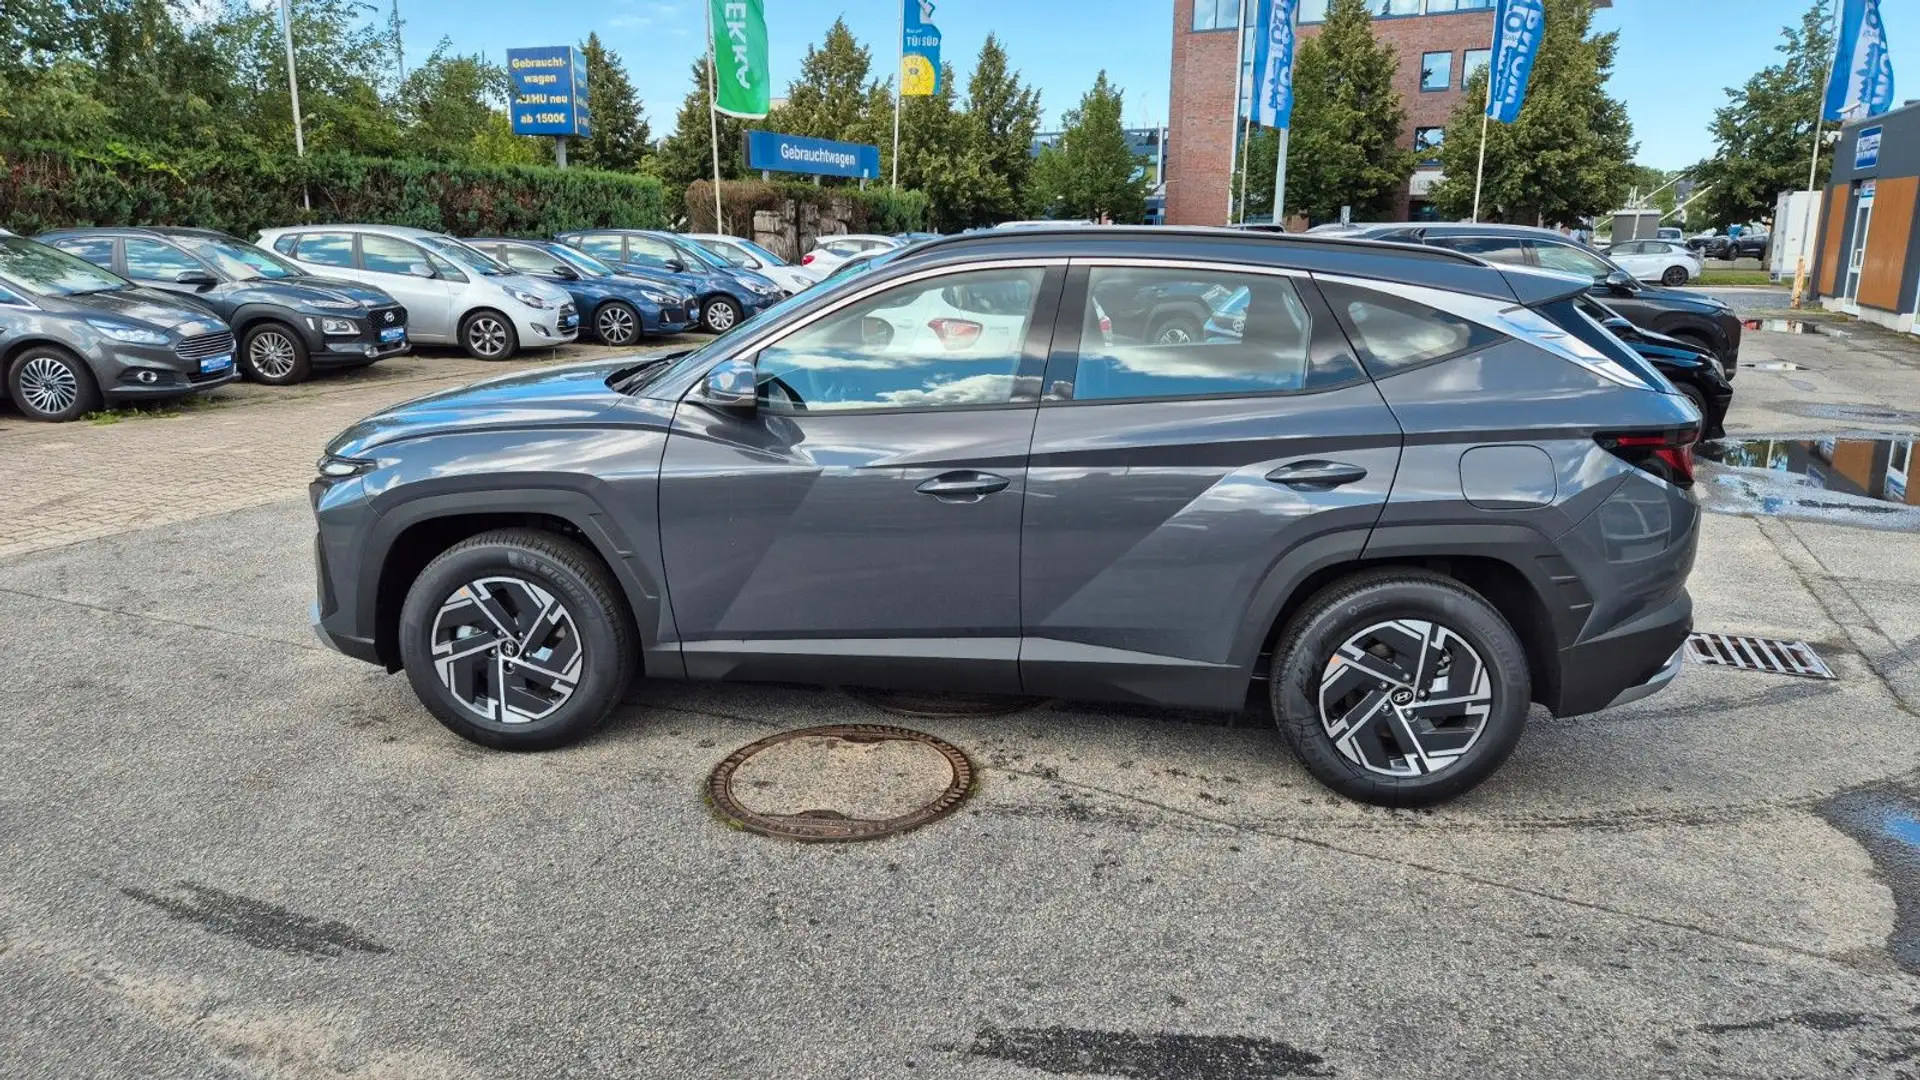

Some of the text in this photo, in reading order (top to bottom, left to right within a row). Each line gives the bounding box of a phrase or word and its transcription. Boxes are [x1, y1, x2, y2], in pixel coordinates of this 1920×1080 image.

[922, 35, 938, 46] SÜD
[511, 57, 567, 68] Gebraucht-
[524, 74, 556, 85] wagen
[549, 95, 567, 104] neu
[520, 112, 566, 124] ab 1500€
[781, 143, 856, 168] Gebrauchtwagen
